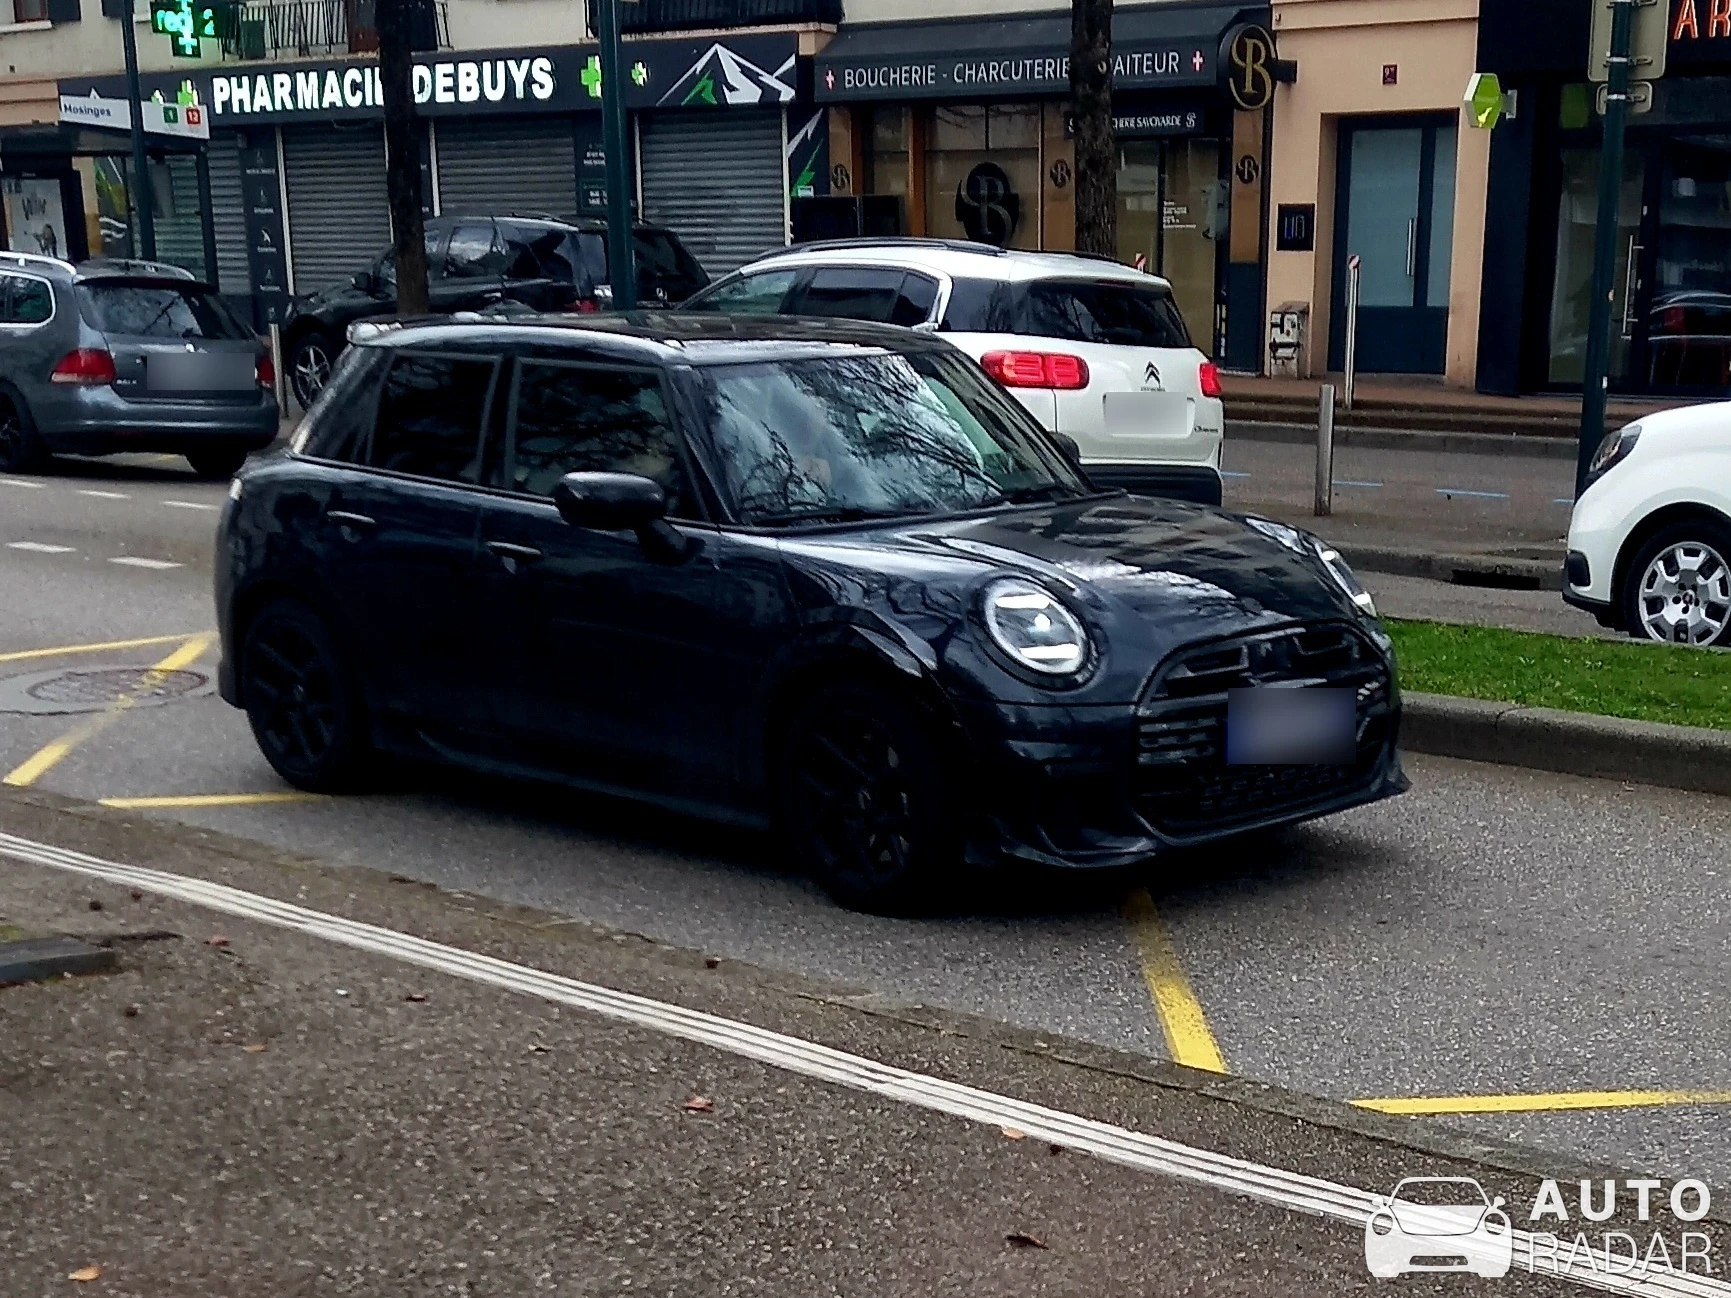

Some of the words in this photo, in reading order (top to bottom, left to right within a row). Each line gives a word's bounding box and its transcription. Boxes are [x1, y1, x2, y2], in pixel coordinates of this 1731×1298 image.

[412, 57, 554, 104] DEBUYS
[844, 65, 936, 90] BOUCHERIE
[1110, 51, 1180, 77] AITEUR
